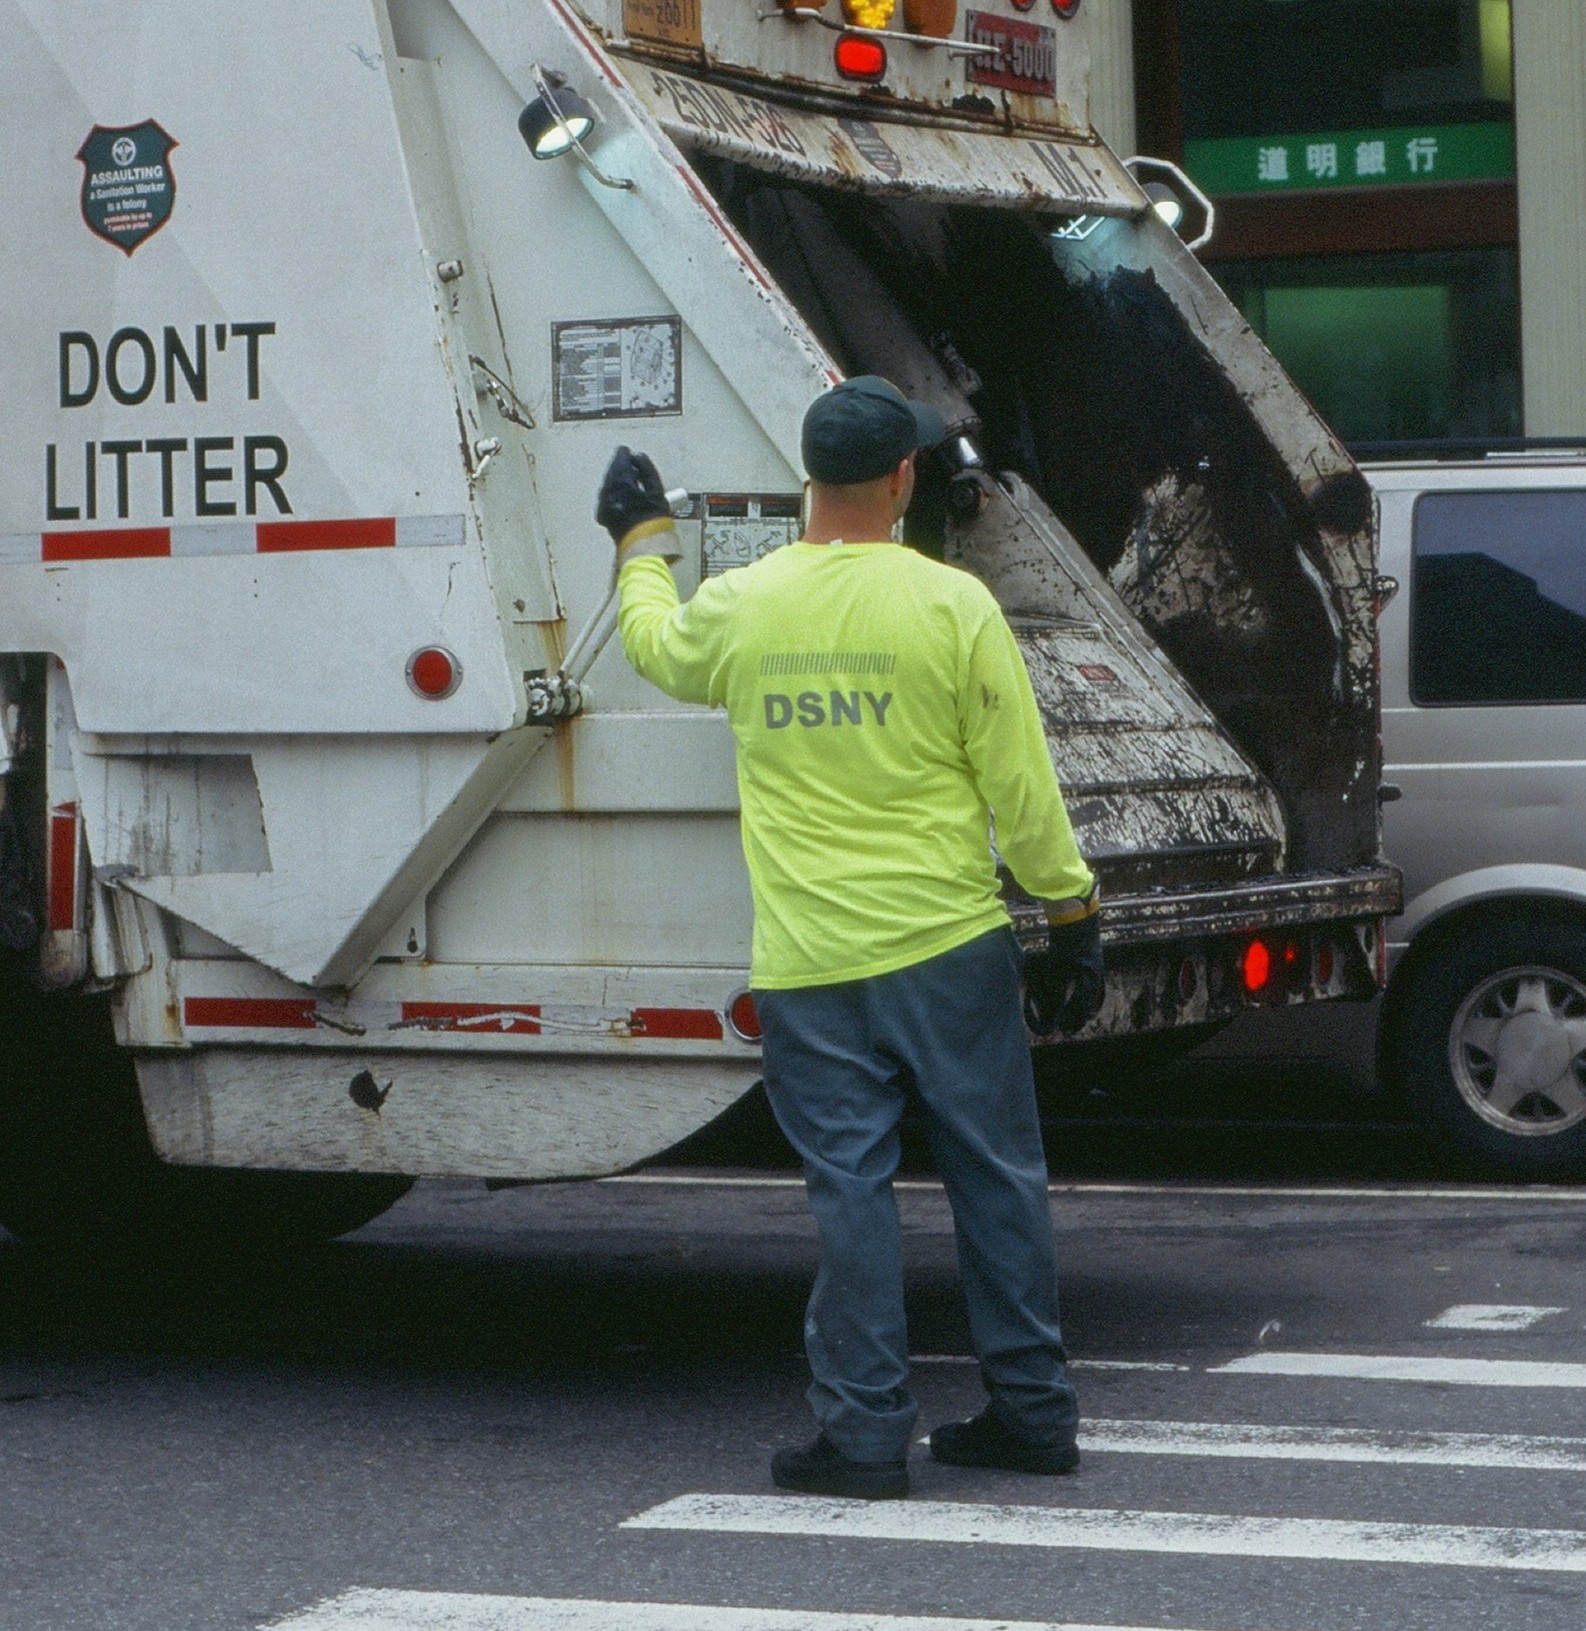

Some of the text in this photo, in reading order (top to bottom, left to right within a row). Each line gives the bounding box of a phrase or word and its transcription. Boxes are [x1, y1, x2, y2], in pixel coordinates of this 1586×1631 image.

[91, 165, 163, 188] ASSAULTING
[135, 182, 165, 194] Worker
[59, 321, 277, 408] DON'T
[46, 435, 294, 521] LITTER
[763, 690, 893, 729] DSNY
